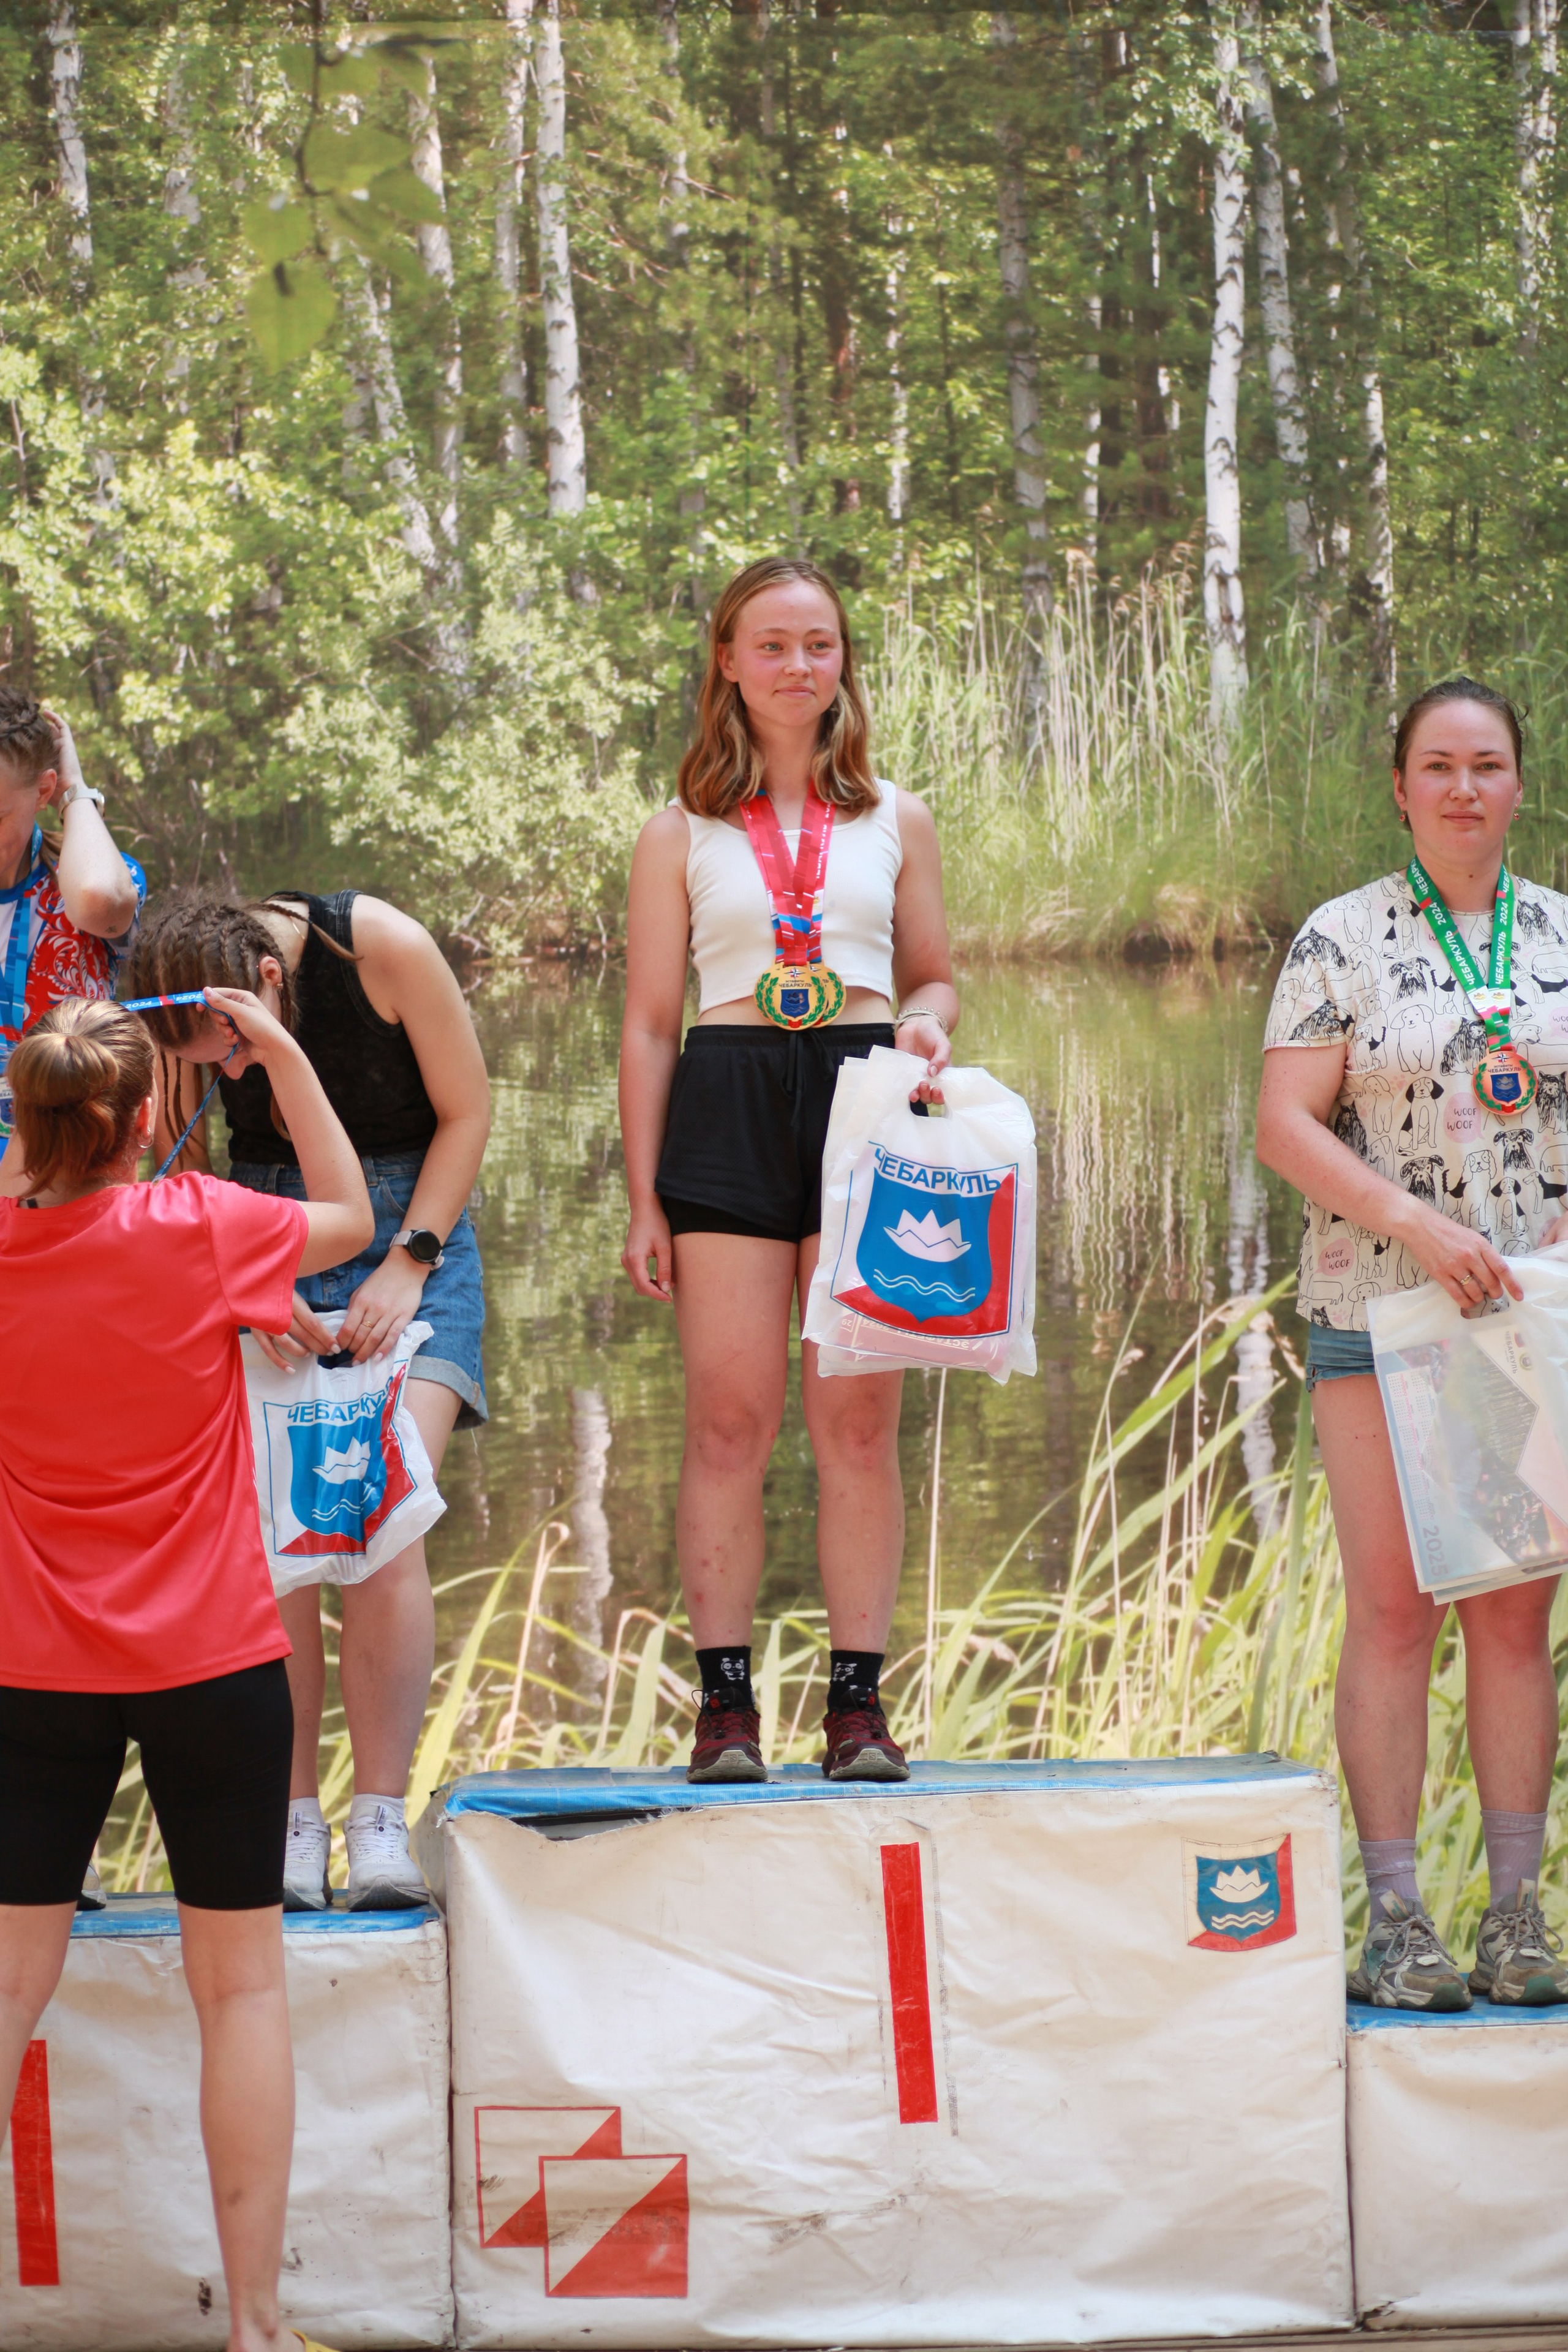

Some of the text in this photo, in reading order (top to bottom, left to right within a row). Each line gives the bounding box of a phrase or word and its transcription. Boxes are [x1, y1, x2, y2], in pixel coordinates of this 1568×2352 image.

[1411, 859, 1429, 895] ЧЕБАРК
[1429, 901, 1446, 925] 2024
[1500, 901, 1509, 925] 2024
[1445, 930, 1476, 986] ЧЕБАРКУЛЬ
[1495, 931, 1507, 985] ЧЕБАРКУЛЬ
[125, 1000, 153, 1009] 2024
[1453, 1107, 1477, 1117] WOOF
[1447, 1120, 1473, 1131] WOOF
[1325, 1249, 1344, 1259] WOOF
[1329, 1259, 1350, 1270] WOOF
[1422, 1525, 1449, 1577] 2025
